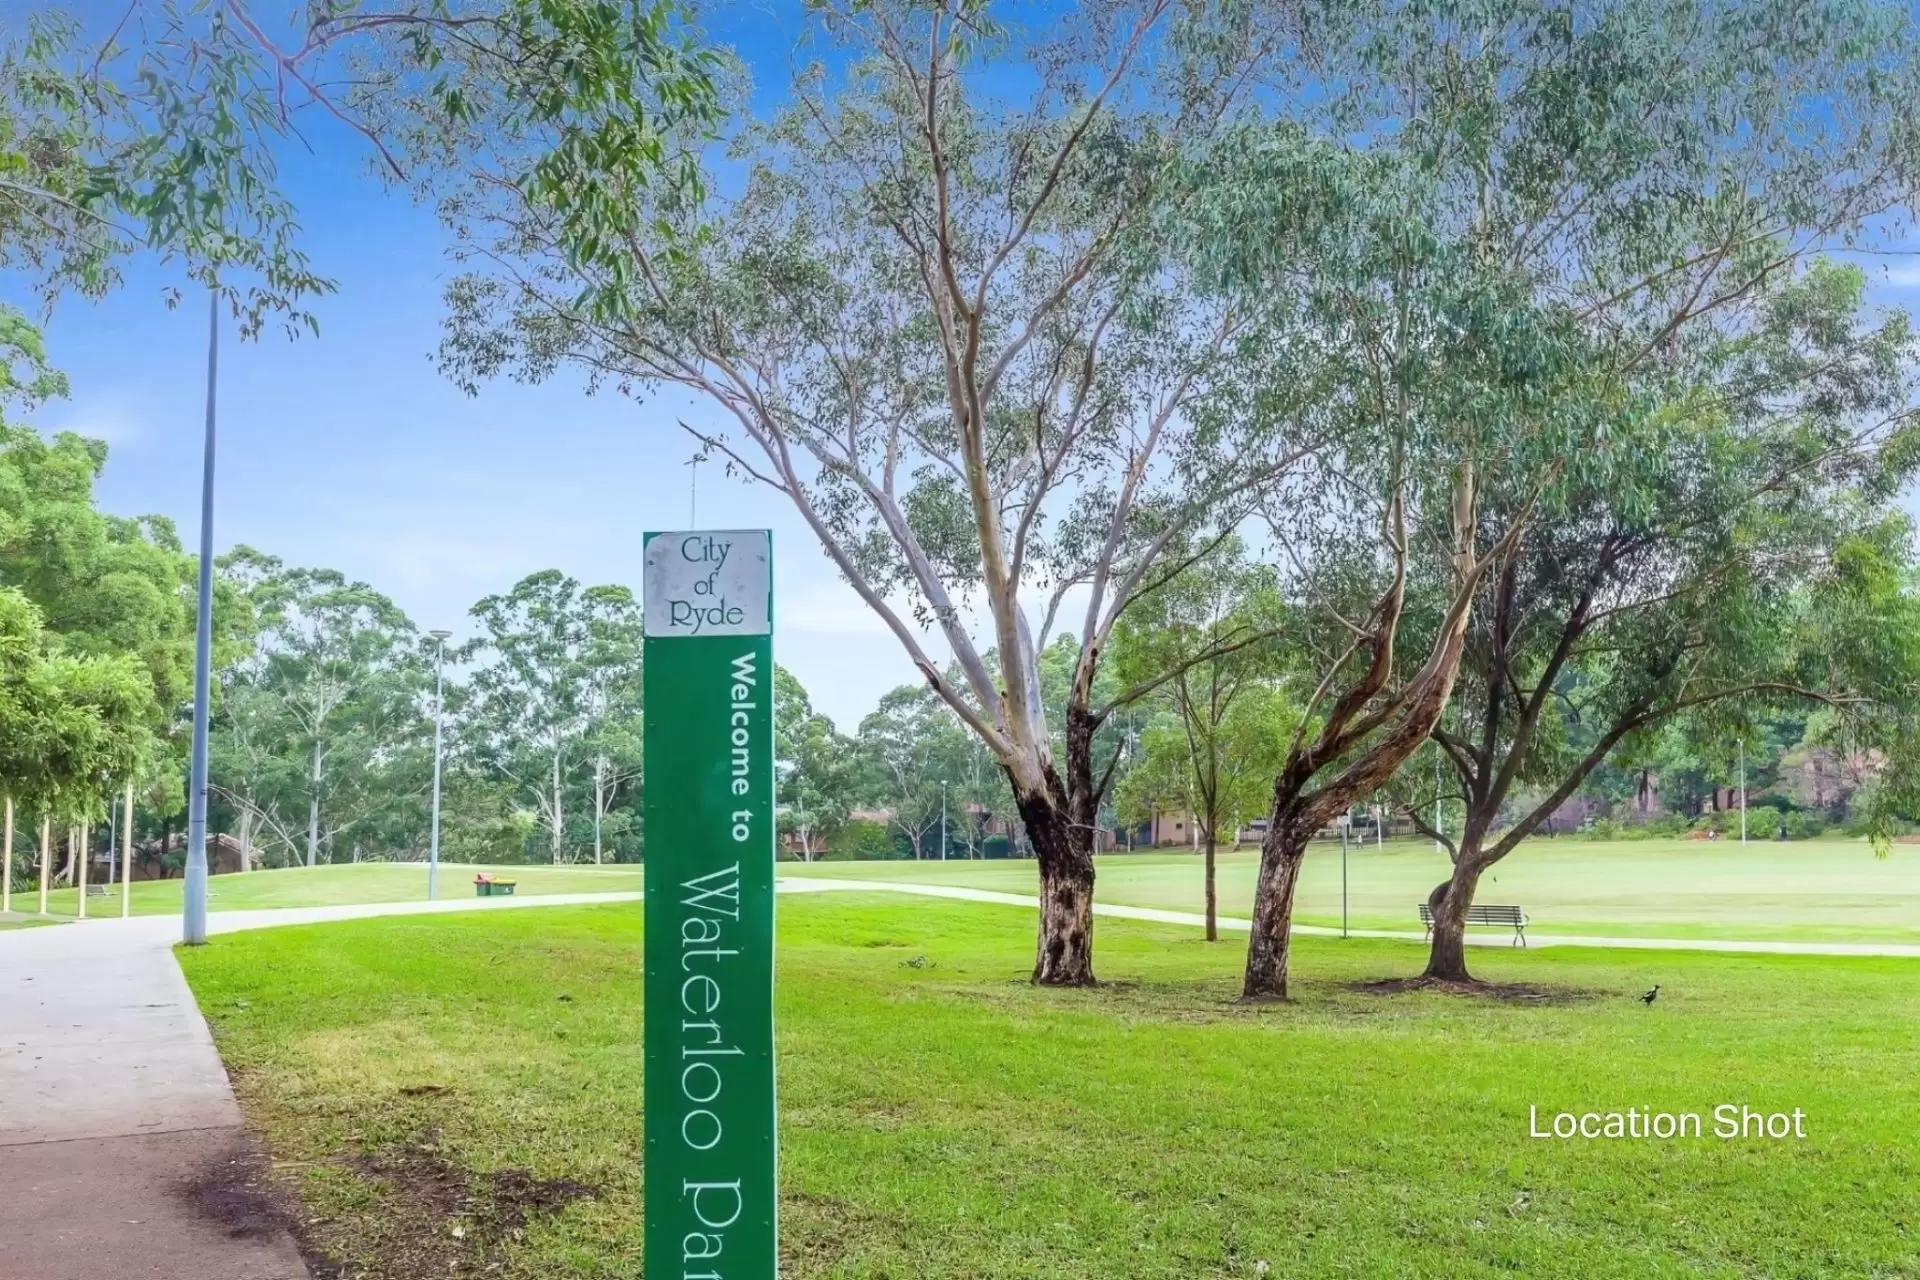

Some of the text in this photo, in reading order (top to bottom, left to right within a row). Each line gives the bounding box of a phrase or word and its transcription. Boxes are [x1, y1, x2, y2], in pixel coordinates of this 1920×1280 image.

[681, 536, 732, 570] City
[694, 572, 718, 597] of
[669, 598, 744, 634] Ryde
[731, 652, 756, 842] Welcome to
[679, 861, 746, 1150] Waterloo
